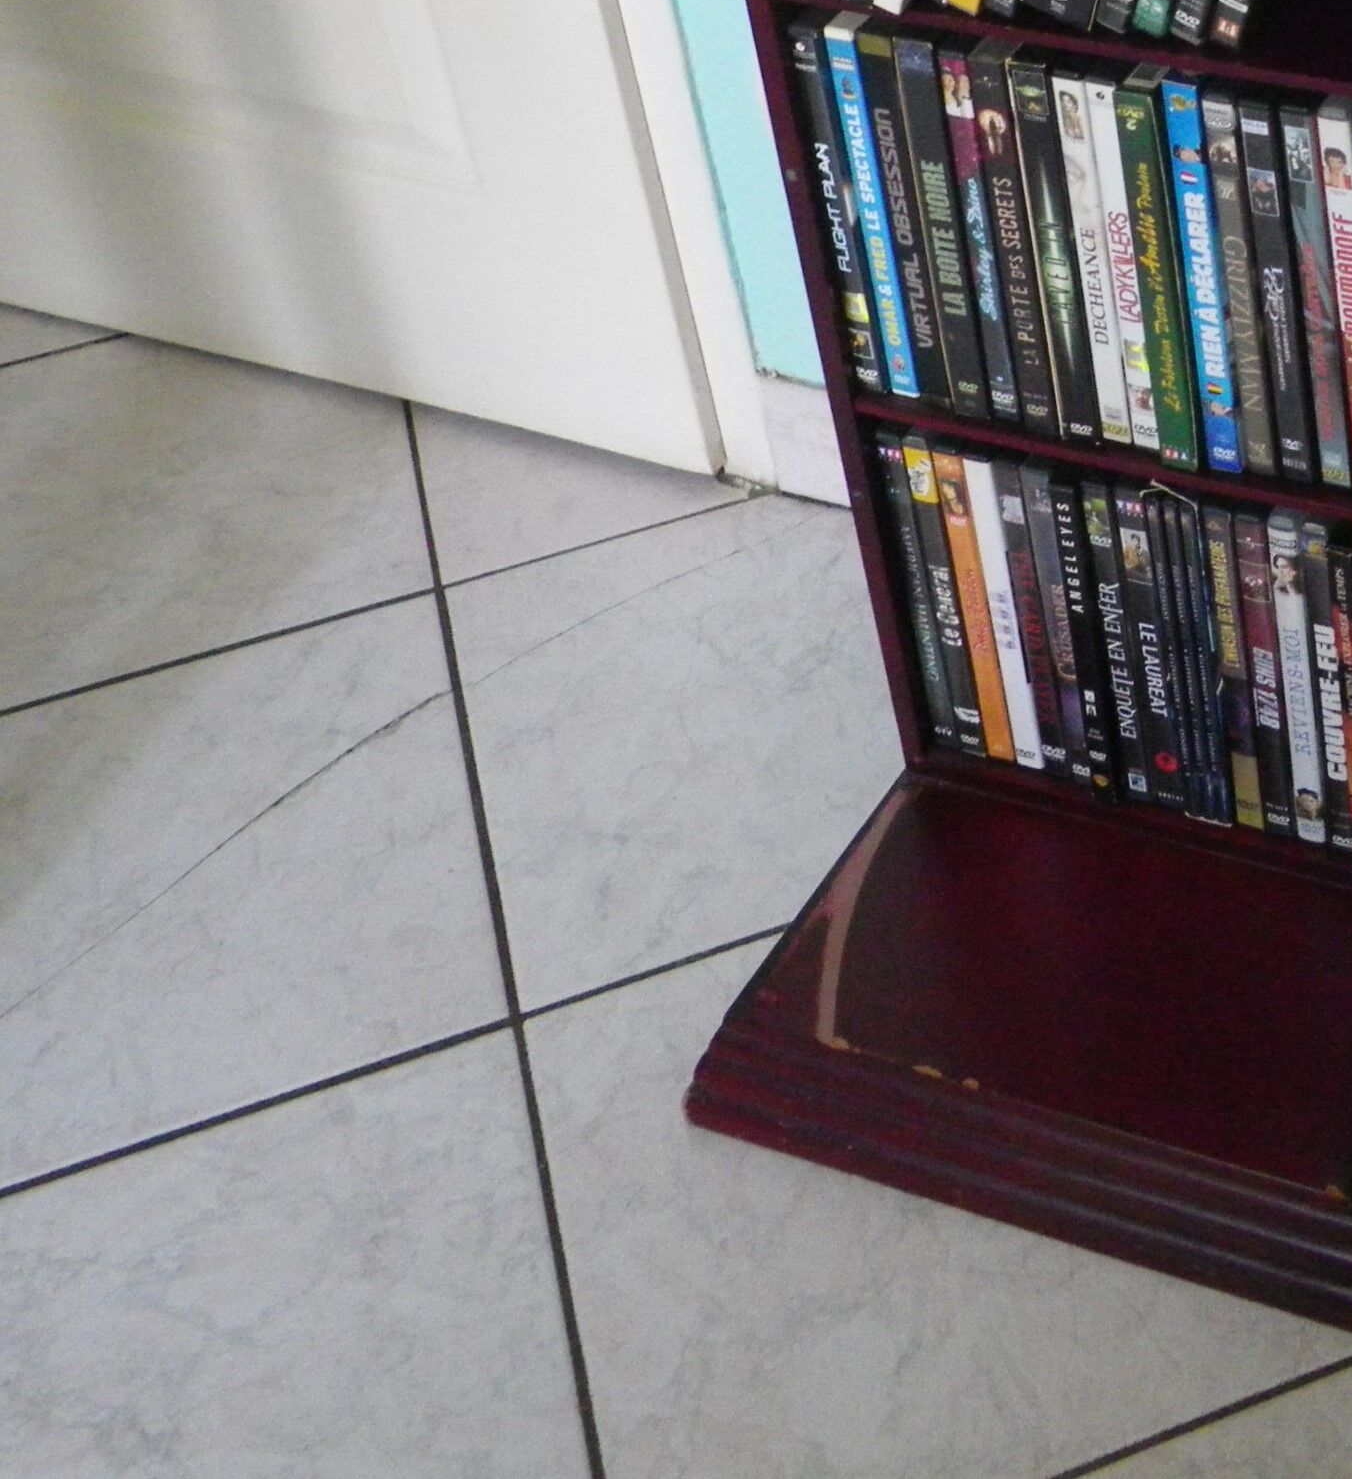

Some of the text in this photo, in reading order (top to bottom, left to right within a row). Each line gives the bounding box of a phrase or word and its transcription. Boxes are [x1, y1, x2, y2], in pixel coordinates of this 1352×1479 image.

[843, 102, 876, 205] SPECTACLE
[815, 142, 852, 273] FLIGHT PLAN
[867, 212, 884, 232] LE
[867, 236, 892, 282] FRED
[873, 106, 933, 350] VIRTUAL OBSESSION
[921, 159, 968, 316] LA BOITE NOIRE
[992, 176, 1021, 251] SECRETS
[1181, 192, 1218, 302] DÉCLARER
[1008, 284, 1036, 342] PORTE
[1082, 226, 1110, 347] DECHEANCE
[1107, 211, 1143, 324] LADYKILLERS
[877, 299, 902, 347] OMAR
[1200, 325, 1226, 379] RIEN
[1222, 236, 1264, 413] GRIZZLY MAN
[1056, 502, 1084, 614] ANGEL EYES
[941, 625, 962, 647] Le
[1103, 640, 1125, 662] EN
[1139, 622, 1168, 719] LE LAUREAT
[1279, 626, 1314, 756] REVIENS-MOI
[1312, 623, 1348, 782] COUVRE-FEU
